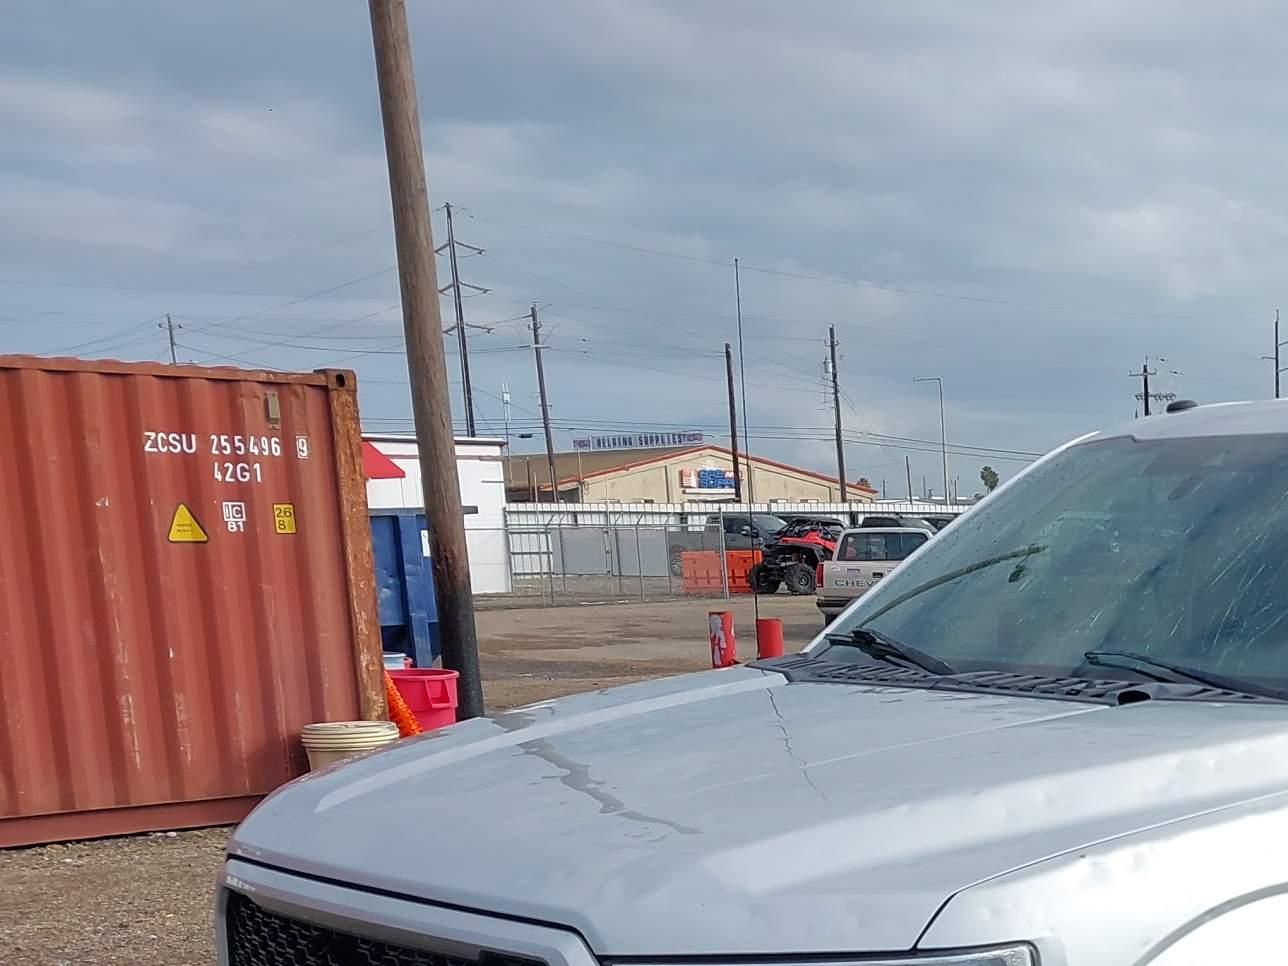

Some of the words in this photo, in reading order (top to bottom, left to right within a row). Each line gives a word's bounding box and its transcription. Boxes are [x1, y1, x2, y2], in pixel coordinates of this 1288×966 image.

[144, 432, 197, 454] ZCSU
[210, 434, 281, 457] 255496
[298, 438, 308, 457] 9
[638, 433, 682, 446] SUPPLIES
[213, 462, 262, 483] 42G1
[228, 521, 244, 532] 81
